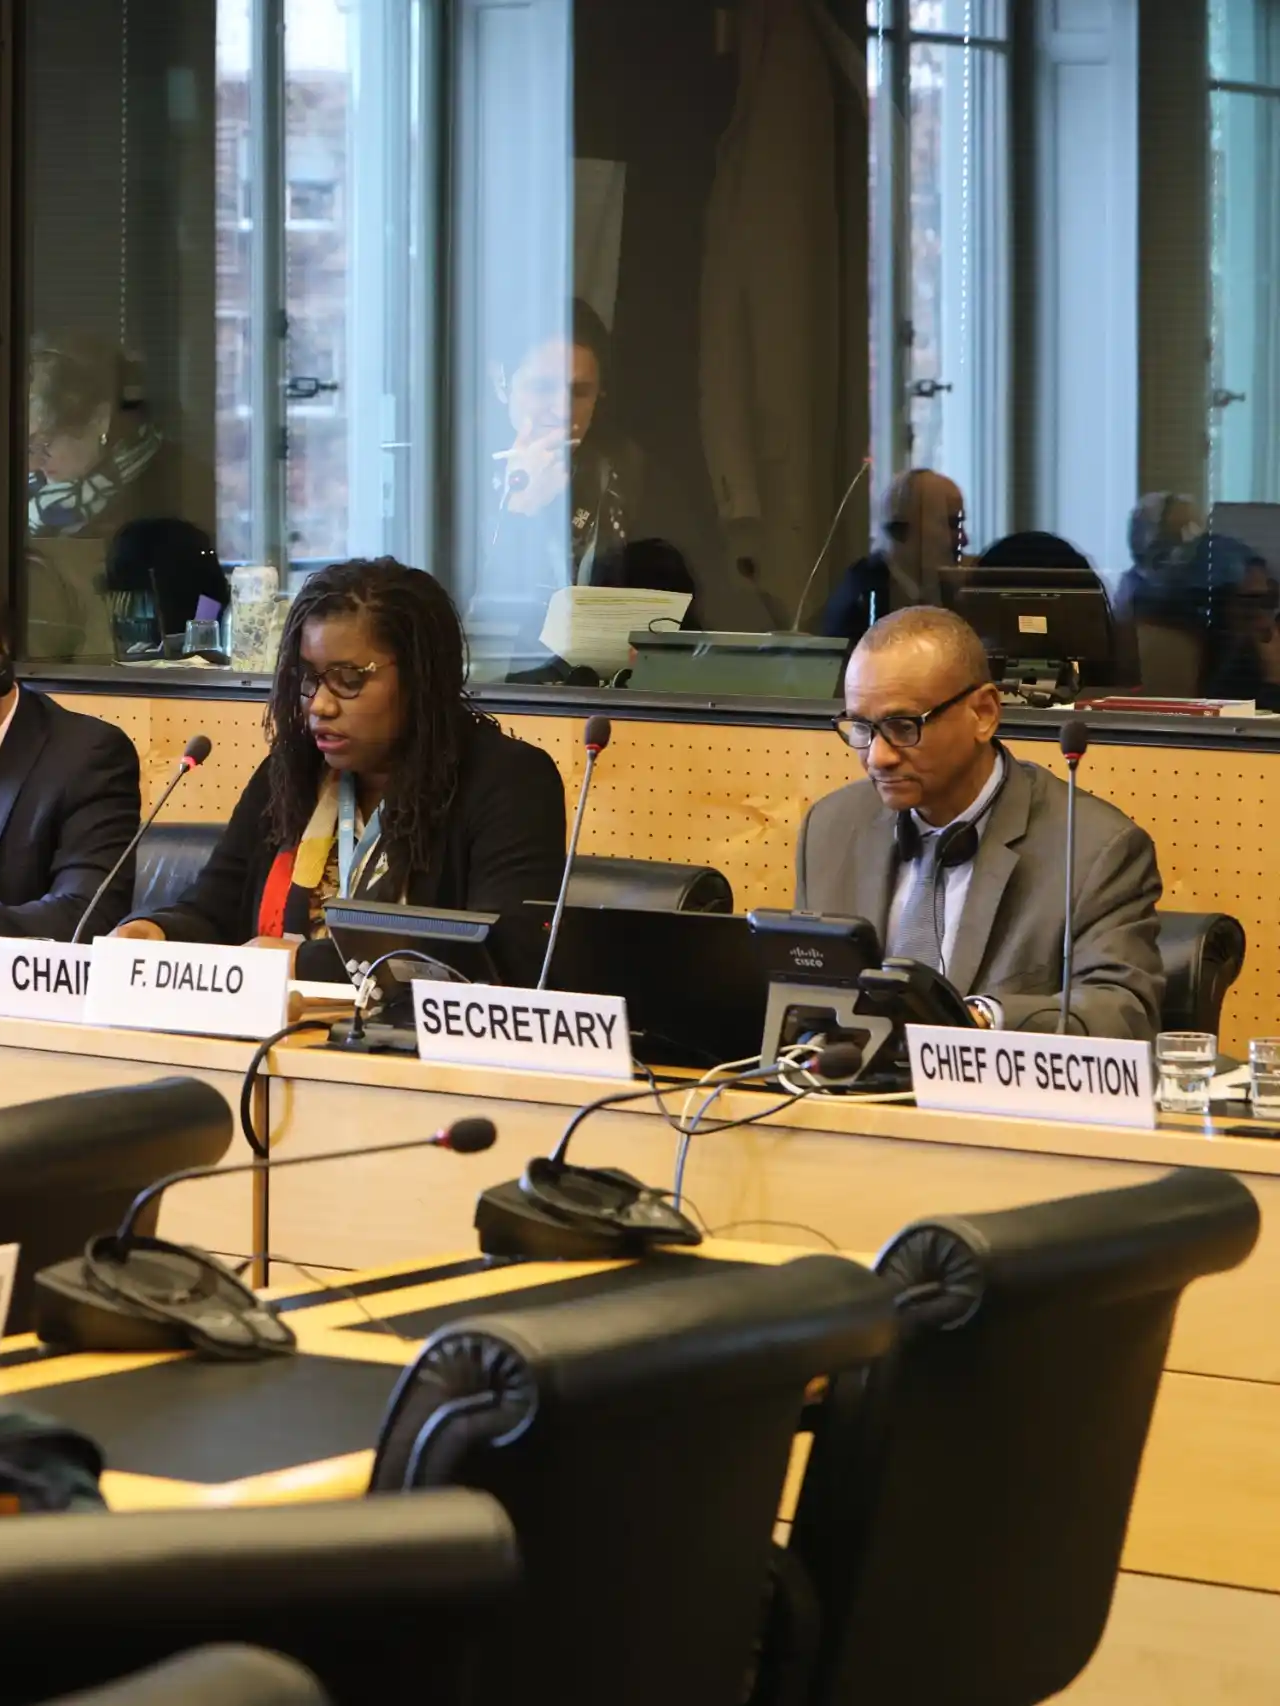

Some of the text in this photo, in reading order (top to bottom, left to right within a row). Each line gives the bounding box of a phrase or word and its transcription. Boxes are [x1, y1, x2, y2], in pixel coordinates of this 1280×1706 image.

[130, 958, 244, 995] F. DIALLO
[422, 998, 617, 1050] SECRETARY
[920, 1042, 1140, 1097] CHIEF OF SECTION
